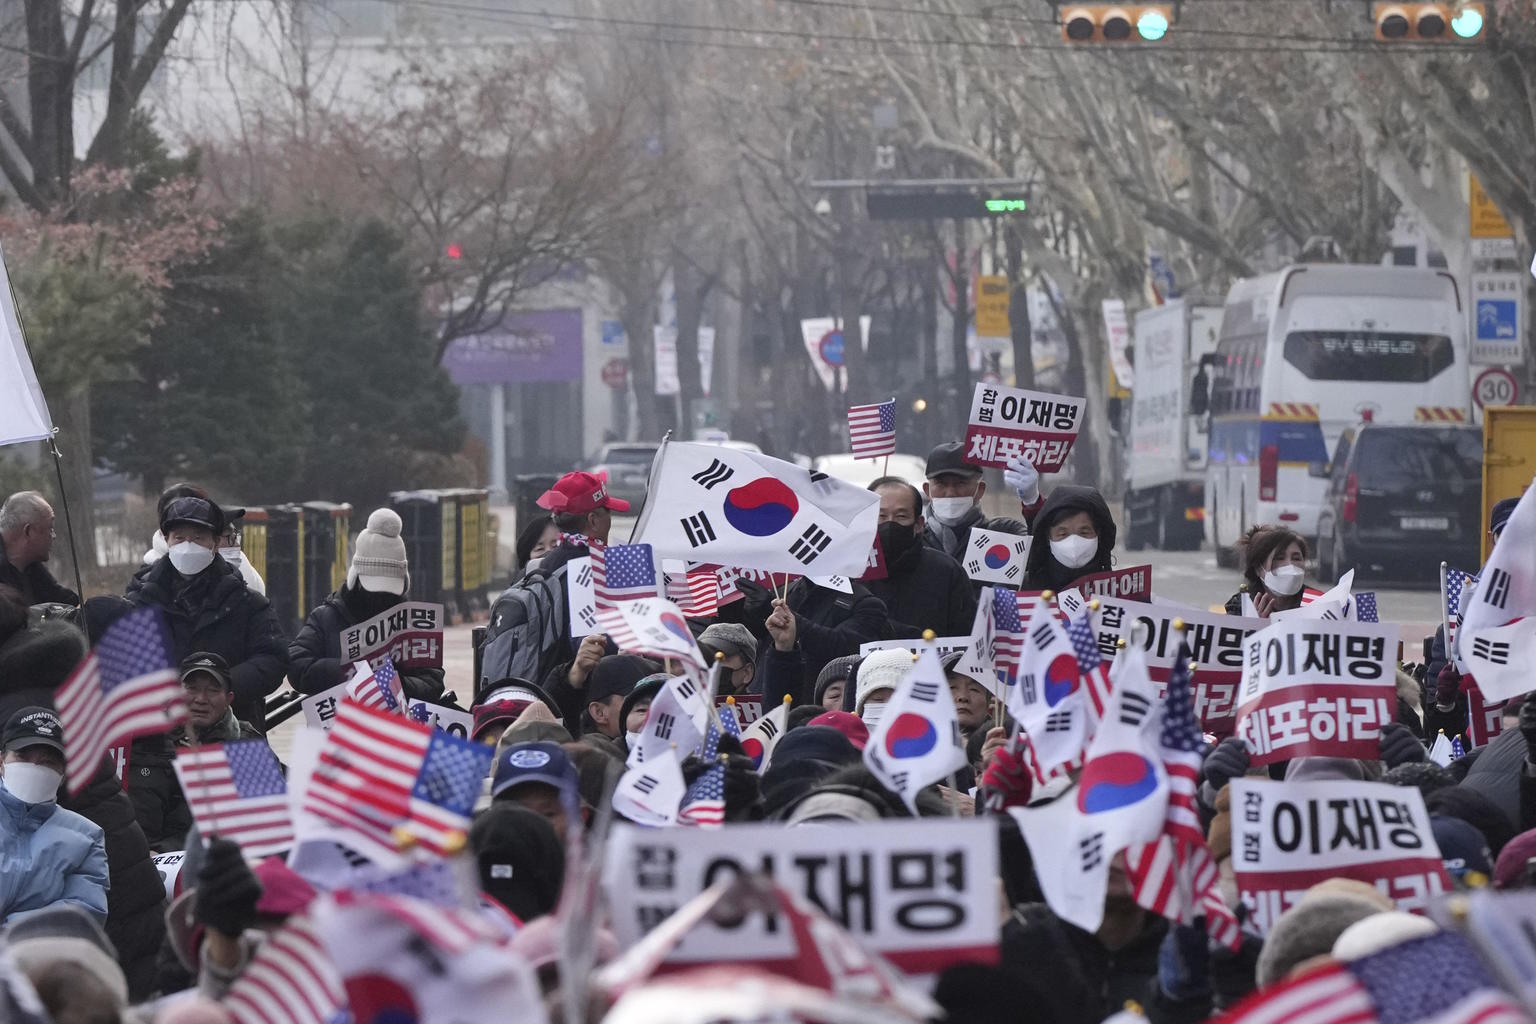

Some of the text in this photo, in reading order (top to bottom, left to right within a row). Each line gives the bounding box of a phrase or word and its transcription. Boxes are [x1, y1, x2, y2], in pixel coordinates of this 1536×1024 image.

[978, 388, 1078, 431] 잡범 이재명
[1482, 380, 1510, 402] 30
[967, 433, 1071, 466] 체포하라
[365, 608, 436, 647] 이재명
[1266, 632, 1385, 680] 이재명
[1237, 696, 1393, 756] 체포하라
[1272, 797, 1424, 855] 이재명
[702, 848, 967, 934] 이재명
